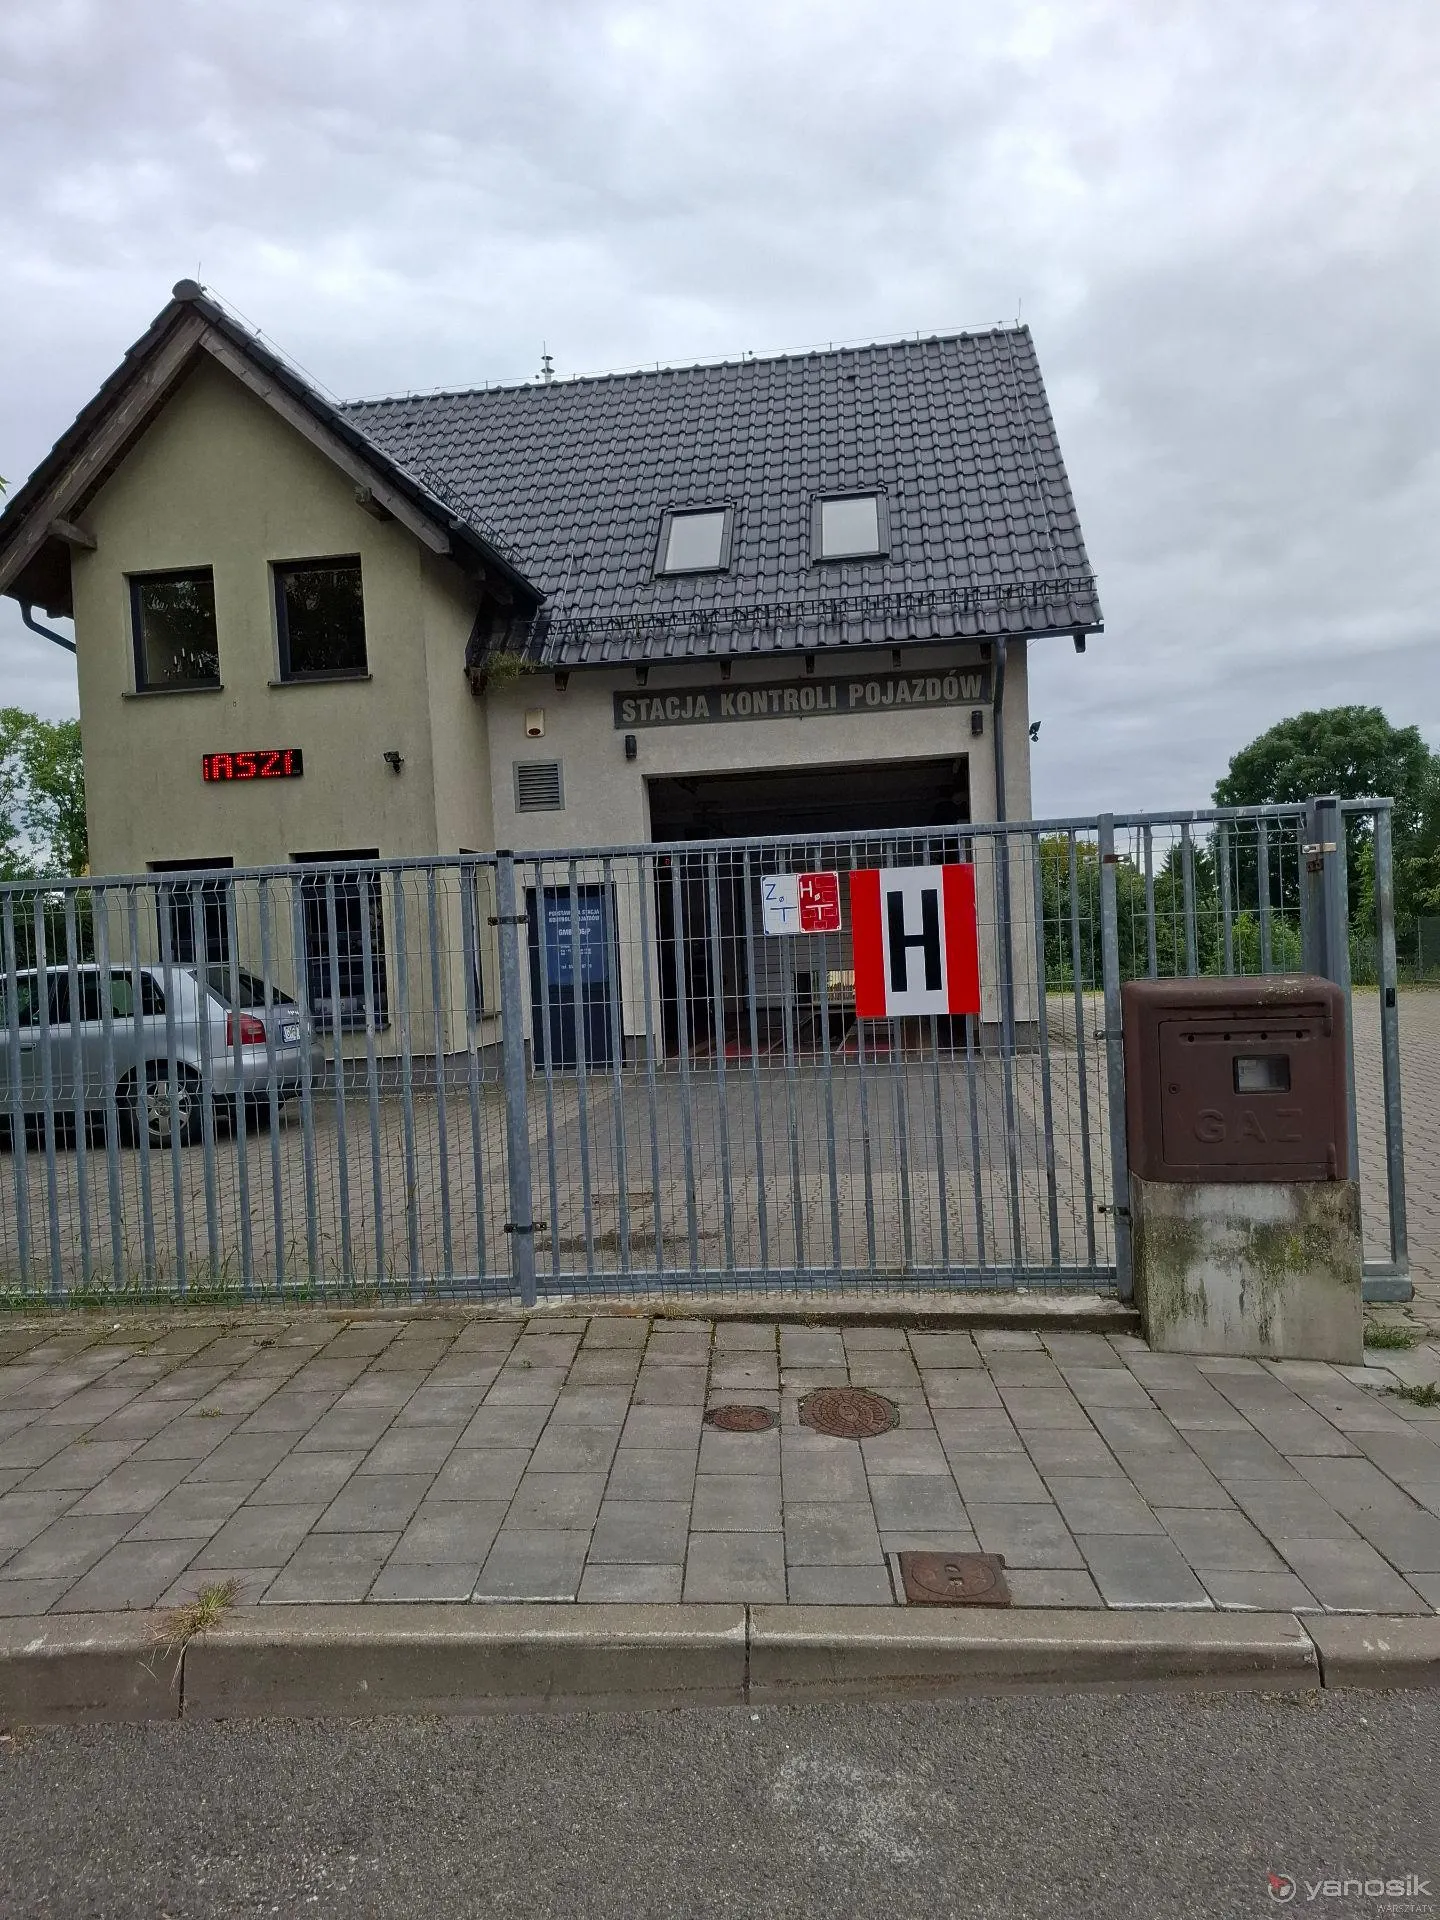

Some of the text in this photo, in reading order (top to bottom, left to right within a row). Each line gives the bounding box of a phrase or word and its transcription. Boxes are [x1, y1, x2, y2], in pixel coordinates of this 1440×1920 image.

[622, 671, 983, 722] STACJA KONTROLI POJAZDÓW
[887, 889, 943, 992] H
[1195, 1107, 1304, 1144] GAZ
